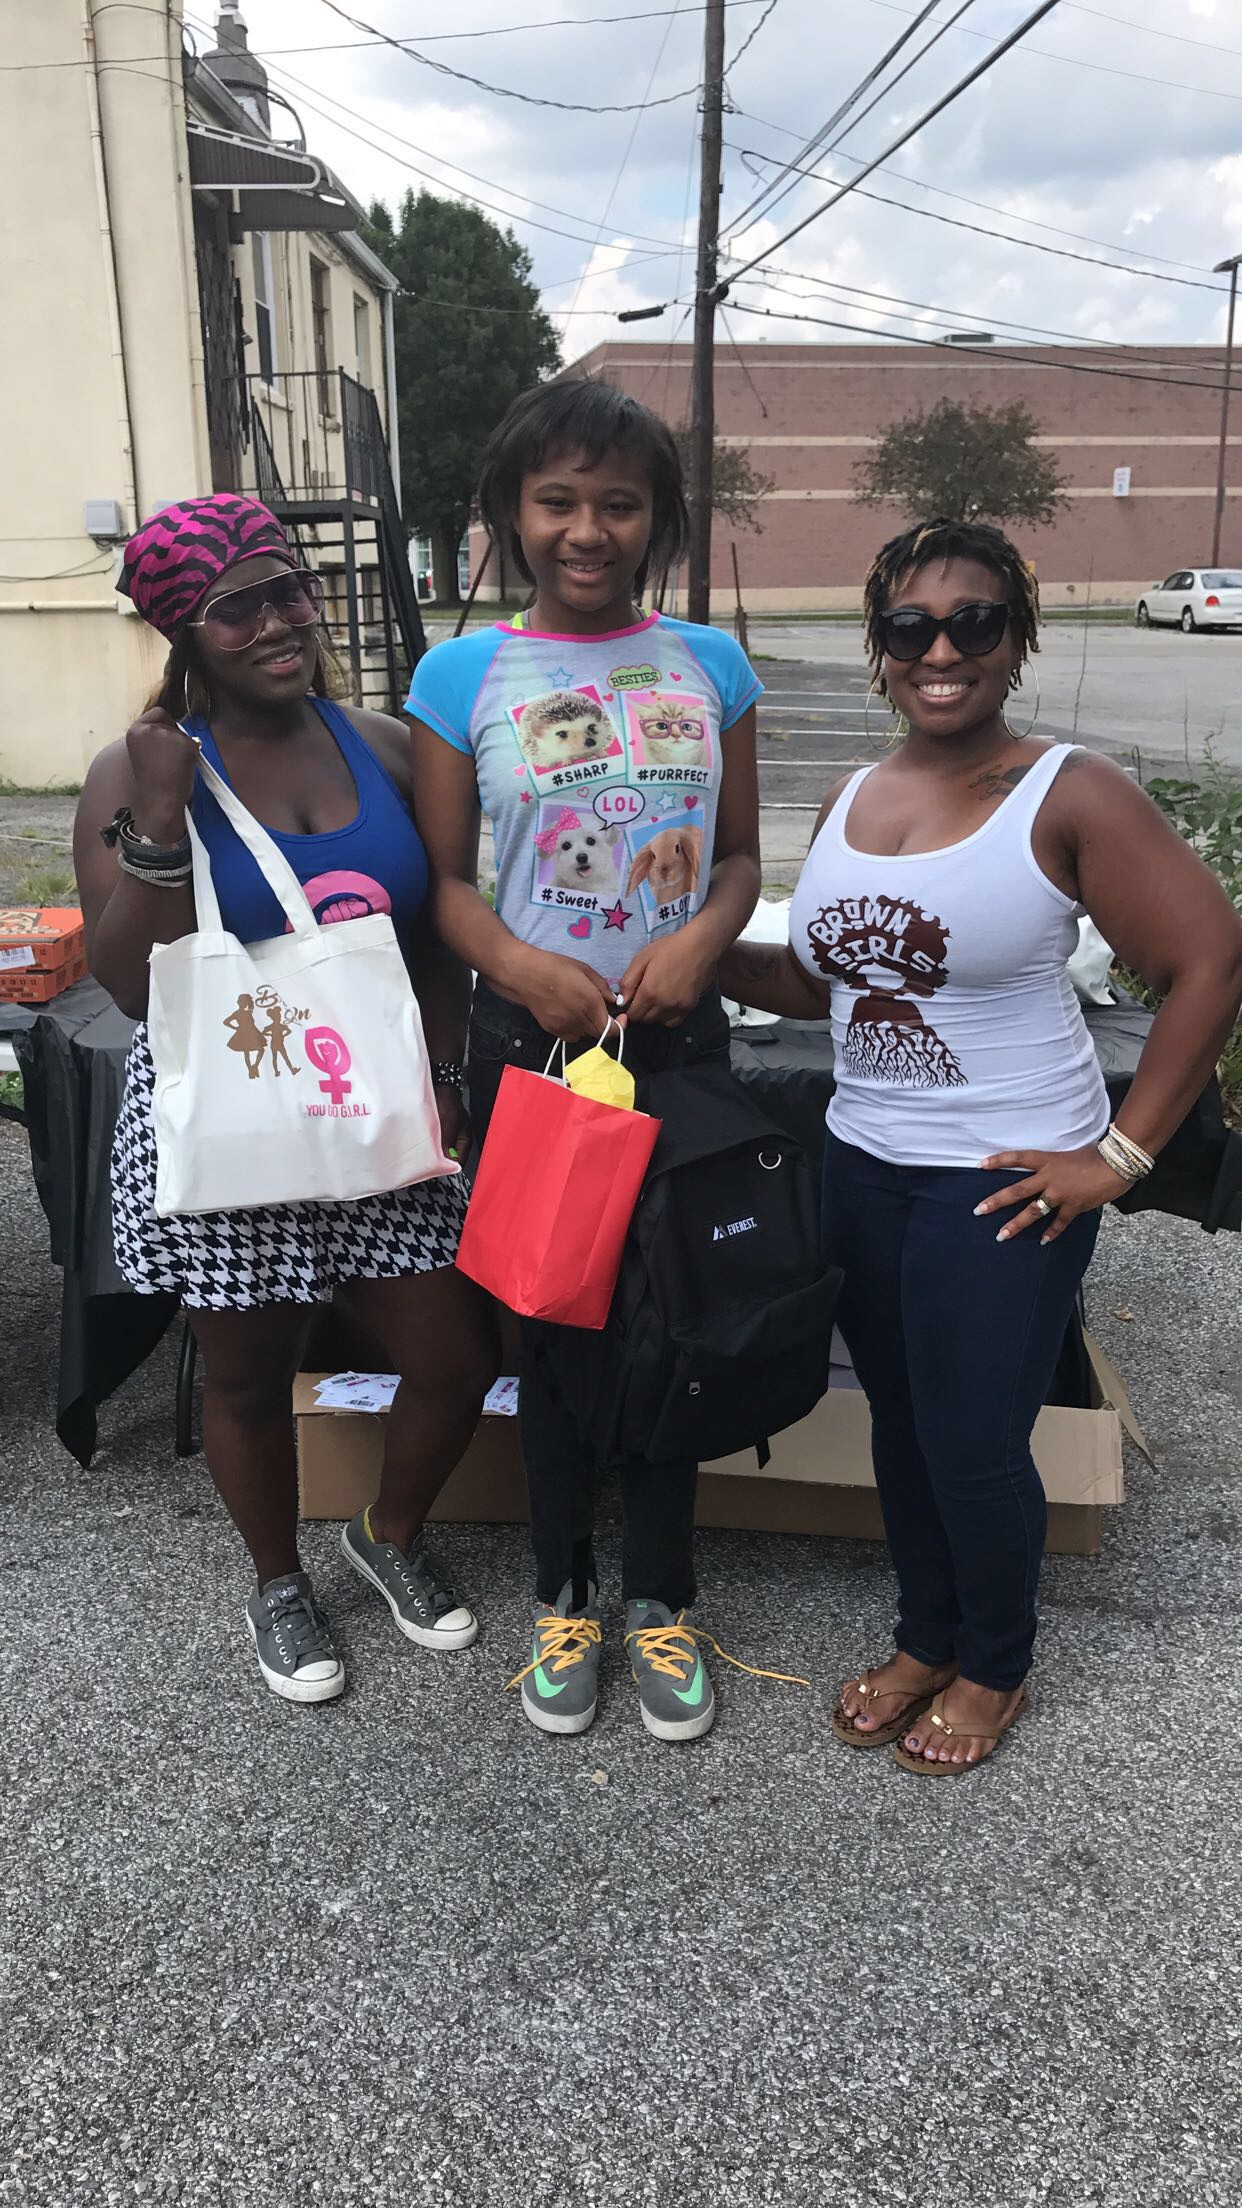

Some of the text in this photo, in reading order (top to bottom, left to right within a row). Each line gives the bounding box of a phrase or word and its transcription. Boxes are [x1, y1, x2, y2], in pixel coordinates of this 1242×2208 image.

[610, 671, 659, 688] BESTIES
[552, 762, 609, 786] #SHARP
[637, 769, 709, 784] #PURRFECT
[602, 796, 638, 812] LOL
[810, 901, 911, 946] BROWN
[828, 935, 936, 973] GIRLS
[306, 1104, 326, 1117] YOU
[327, 1104, 339, 1118] GO
